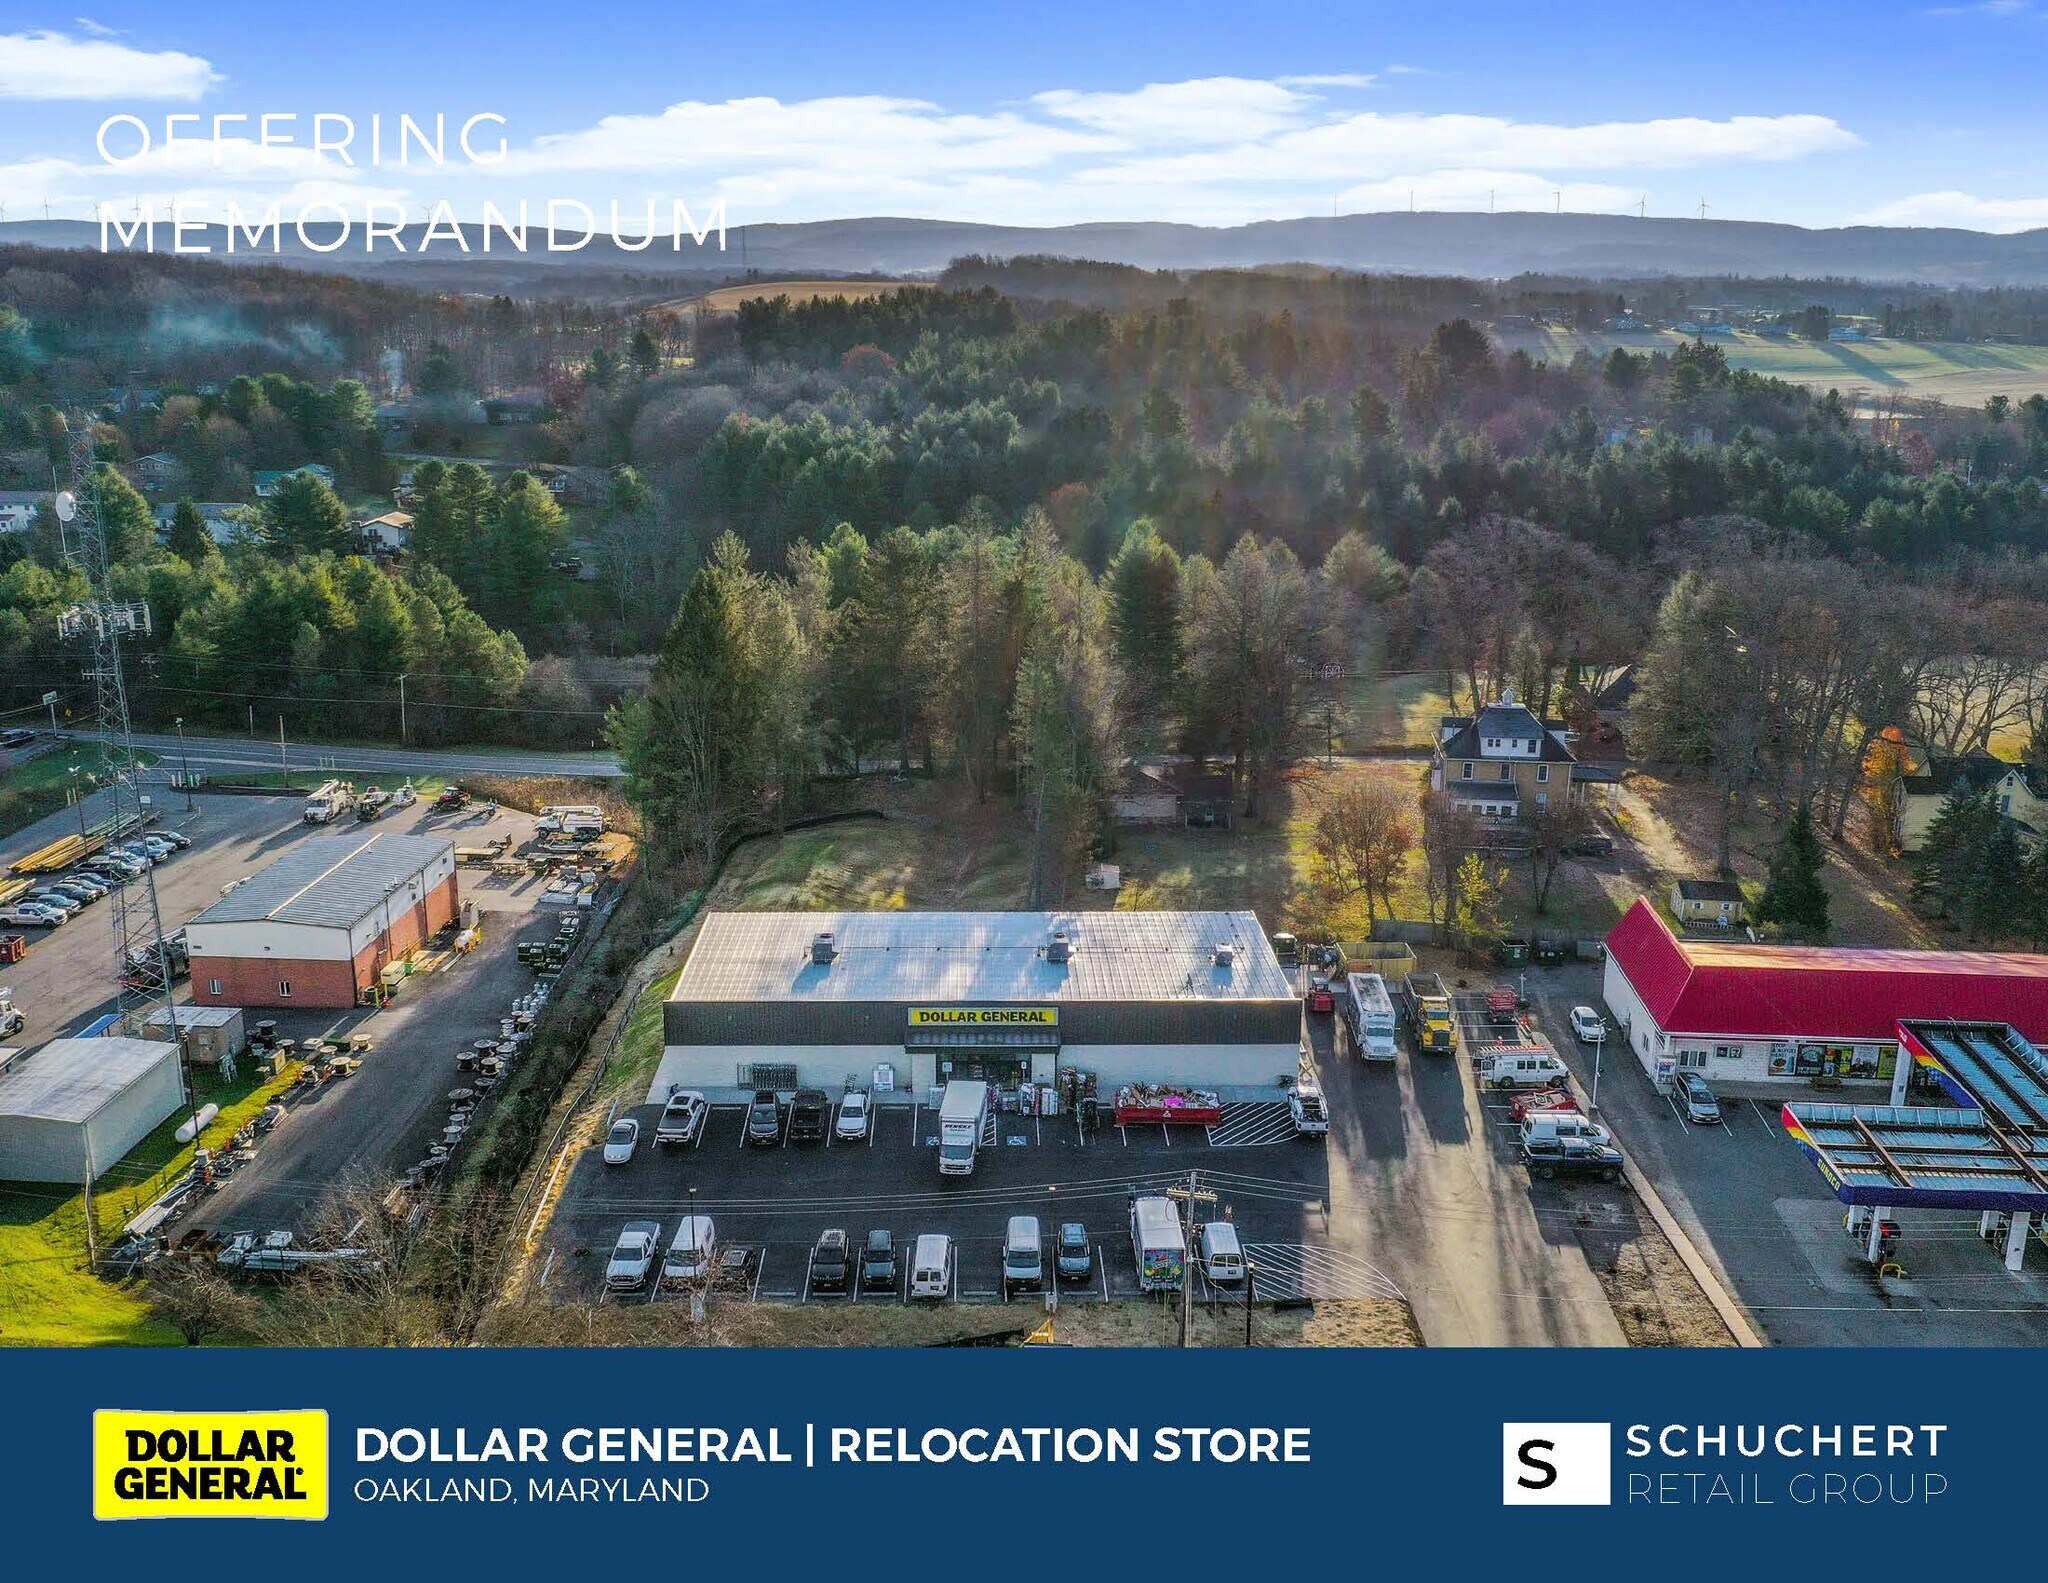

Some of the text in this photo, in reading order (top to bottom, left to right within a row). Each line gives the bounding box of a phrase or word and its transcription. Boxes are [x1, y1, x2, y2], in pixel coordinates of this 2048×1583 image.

[919, 1011, 1047, 1023] DOLLAR GENERAL
[1817, 1158, 1841, 1191] SUNOCO
